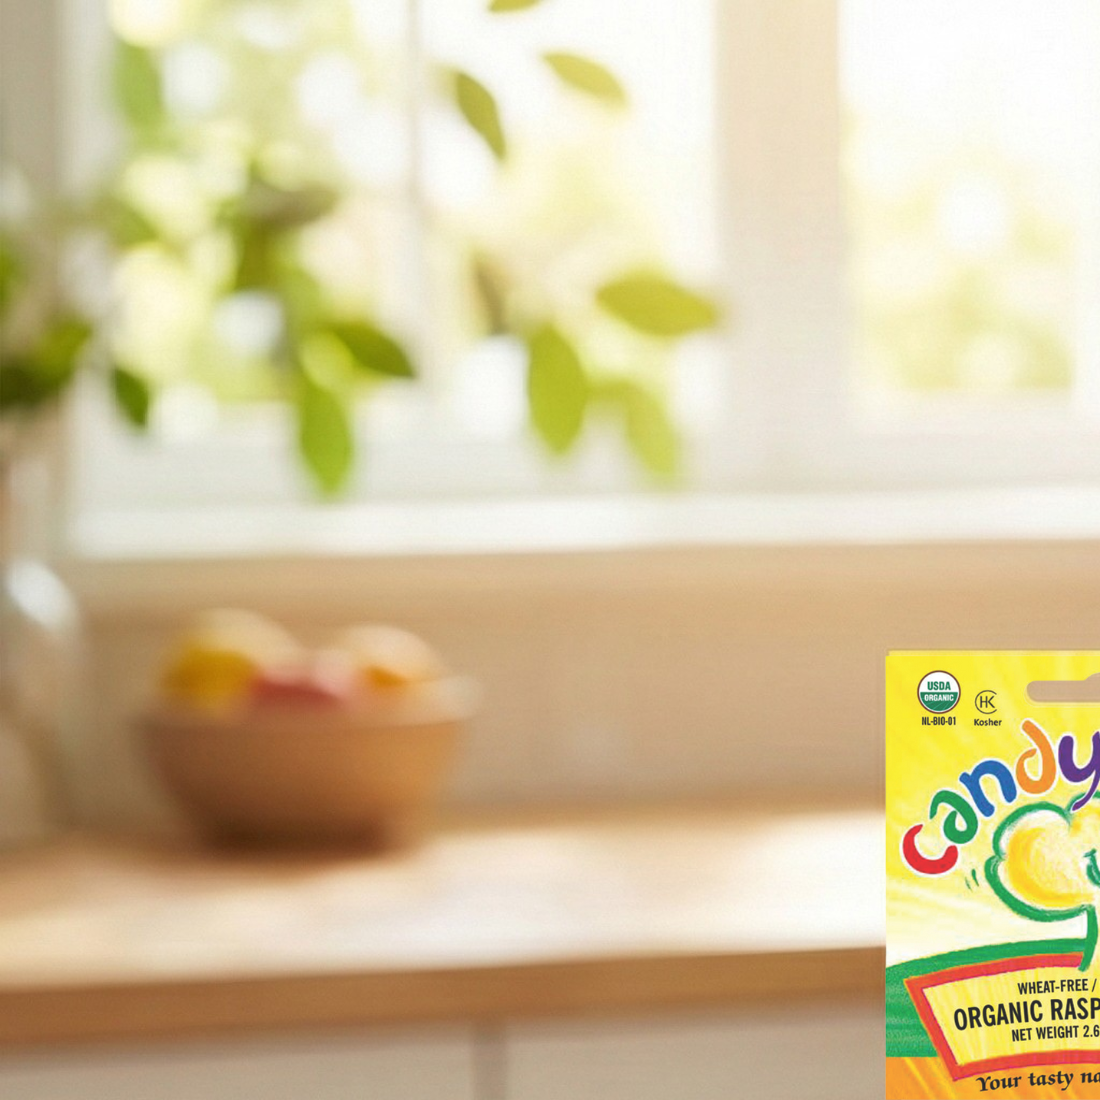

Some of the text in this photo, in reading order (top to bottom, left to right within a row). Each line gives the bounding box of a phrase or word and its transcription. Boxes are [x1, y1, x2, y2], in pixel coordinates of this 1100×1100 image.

[927, 681, 951, 691] USDA
[924, 694, 954, 702] ORGANIC
[921, 716, 956, 726] NL-BIO-01
[973, 718, 1002, 727] Kosher
[1017, 978, 1089, 995] WHEAT-FREE
[954, 999, 1043, 1032] ORGANIC
[1012, 1027, 1034, 1042] NET
[1036, 1025, 1079, 1041] WEIGHT
[1083, 1025, 1100, 1039] 2.6
[976, 1076, 1022, 1093] Your
[1027, 1071, 1074, 1091] tasty
